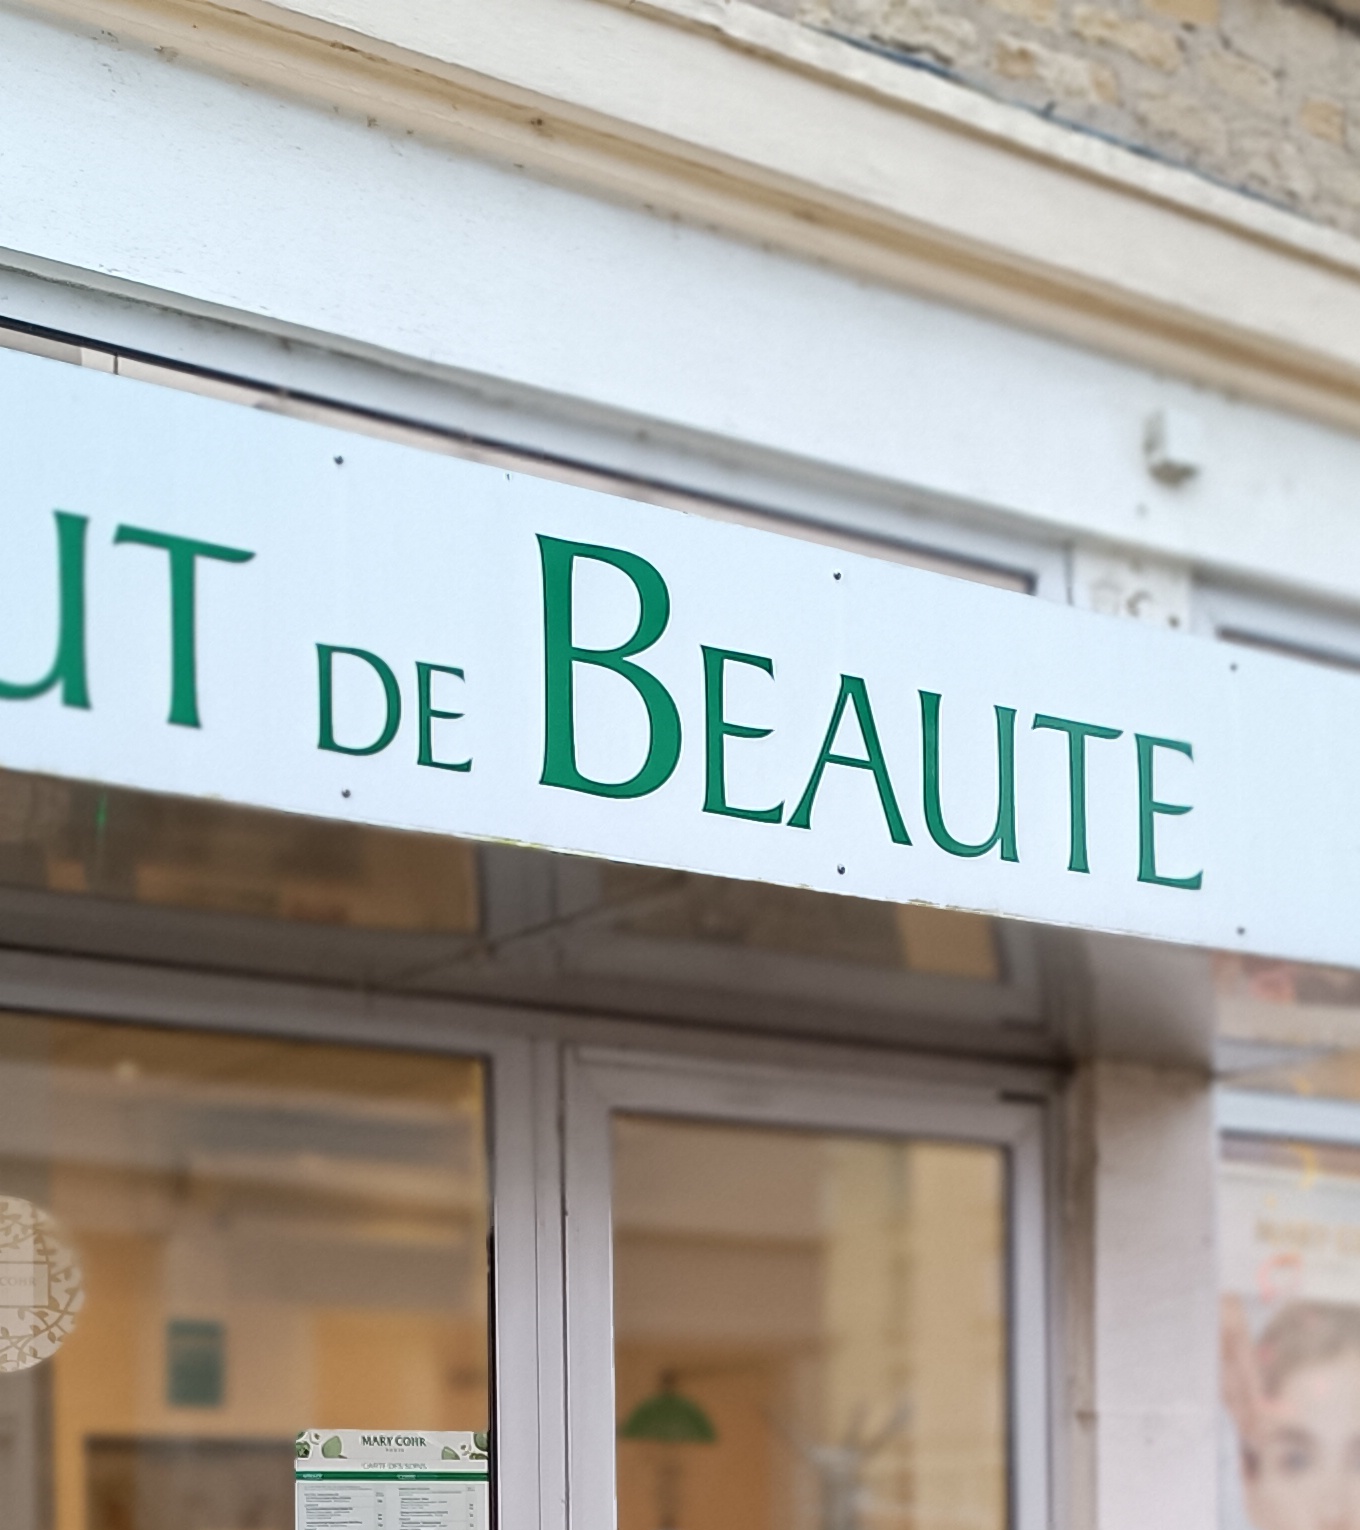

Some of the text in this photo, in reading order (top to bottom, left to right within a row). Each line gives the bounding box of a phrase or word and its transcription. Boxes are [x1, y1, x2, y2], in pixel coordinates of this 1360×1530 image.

[315, 642, 473, 773] DE
[536, 532, 1204, 891] BEAUTE
[361, 1435, 427, 1447] MARY COHR
